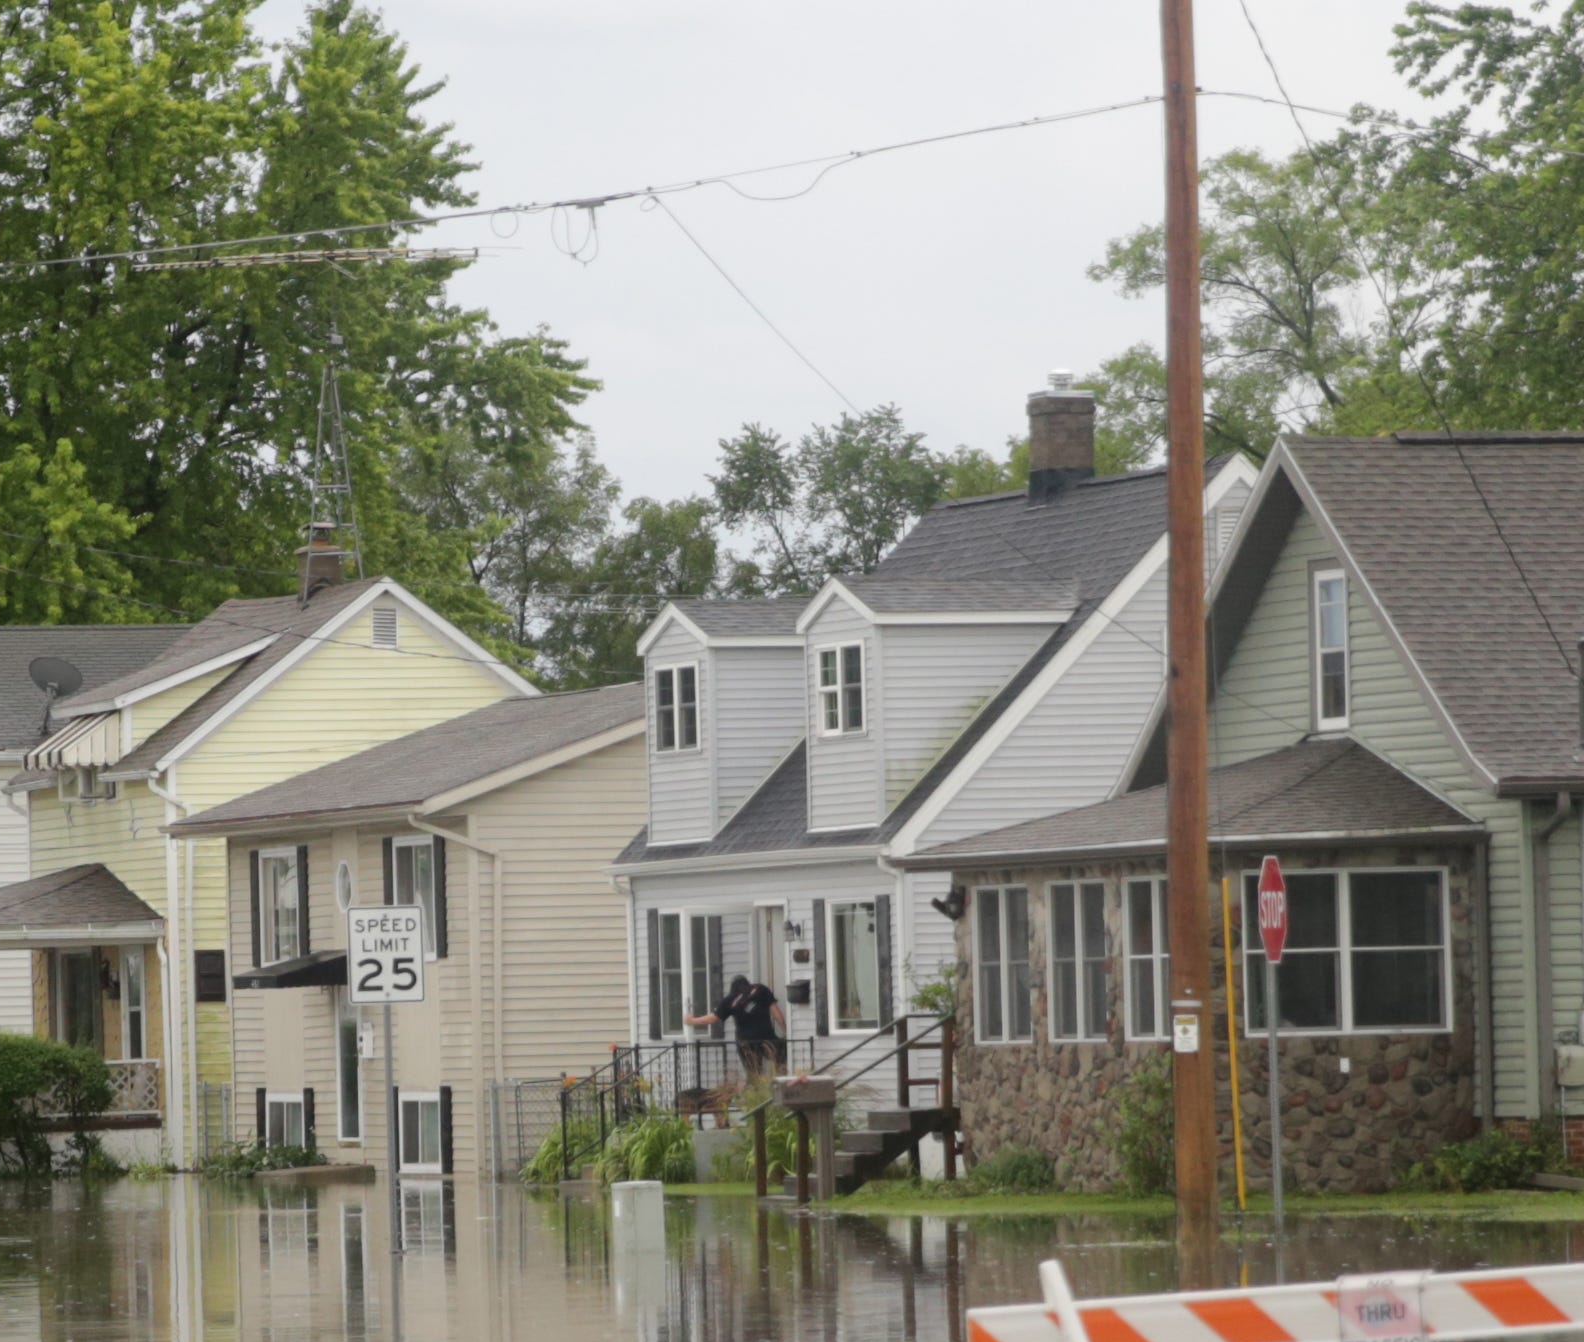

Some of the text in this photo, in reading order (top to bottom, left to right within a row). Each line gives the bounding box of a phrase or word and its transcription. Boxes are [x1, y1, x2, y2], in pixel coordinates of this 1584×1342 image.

[1260, 891, 1285, 928] STOP
[355, 918, 416, 933] SPEED
[362, 937, 409, 952] LIMIT
[357, 957, 417, 991] 25
[1355, 1303, 1406, 1322] THRU
